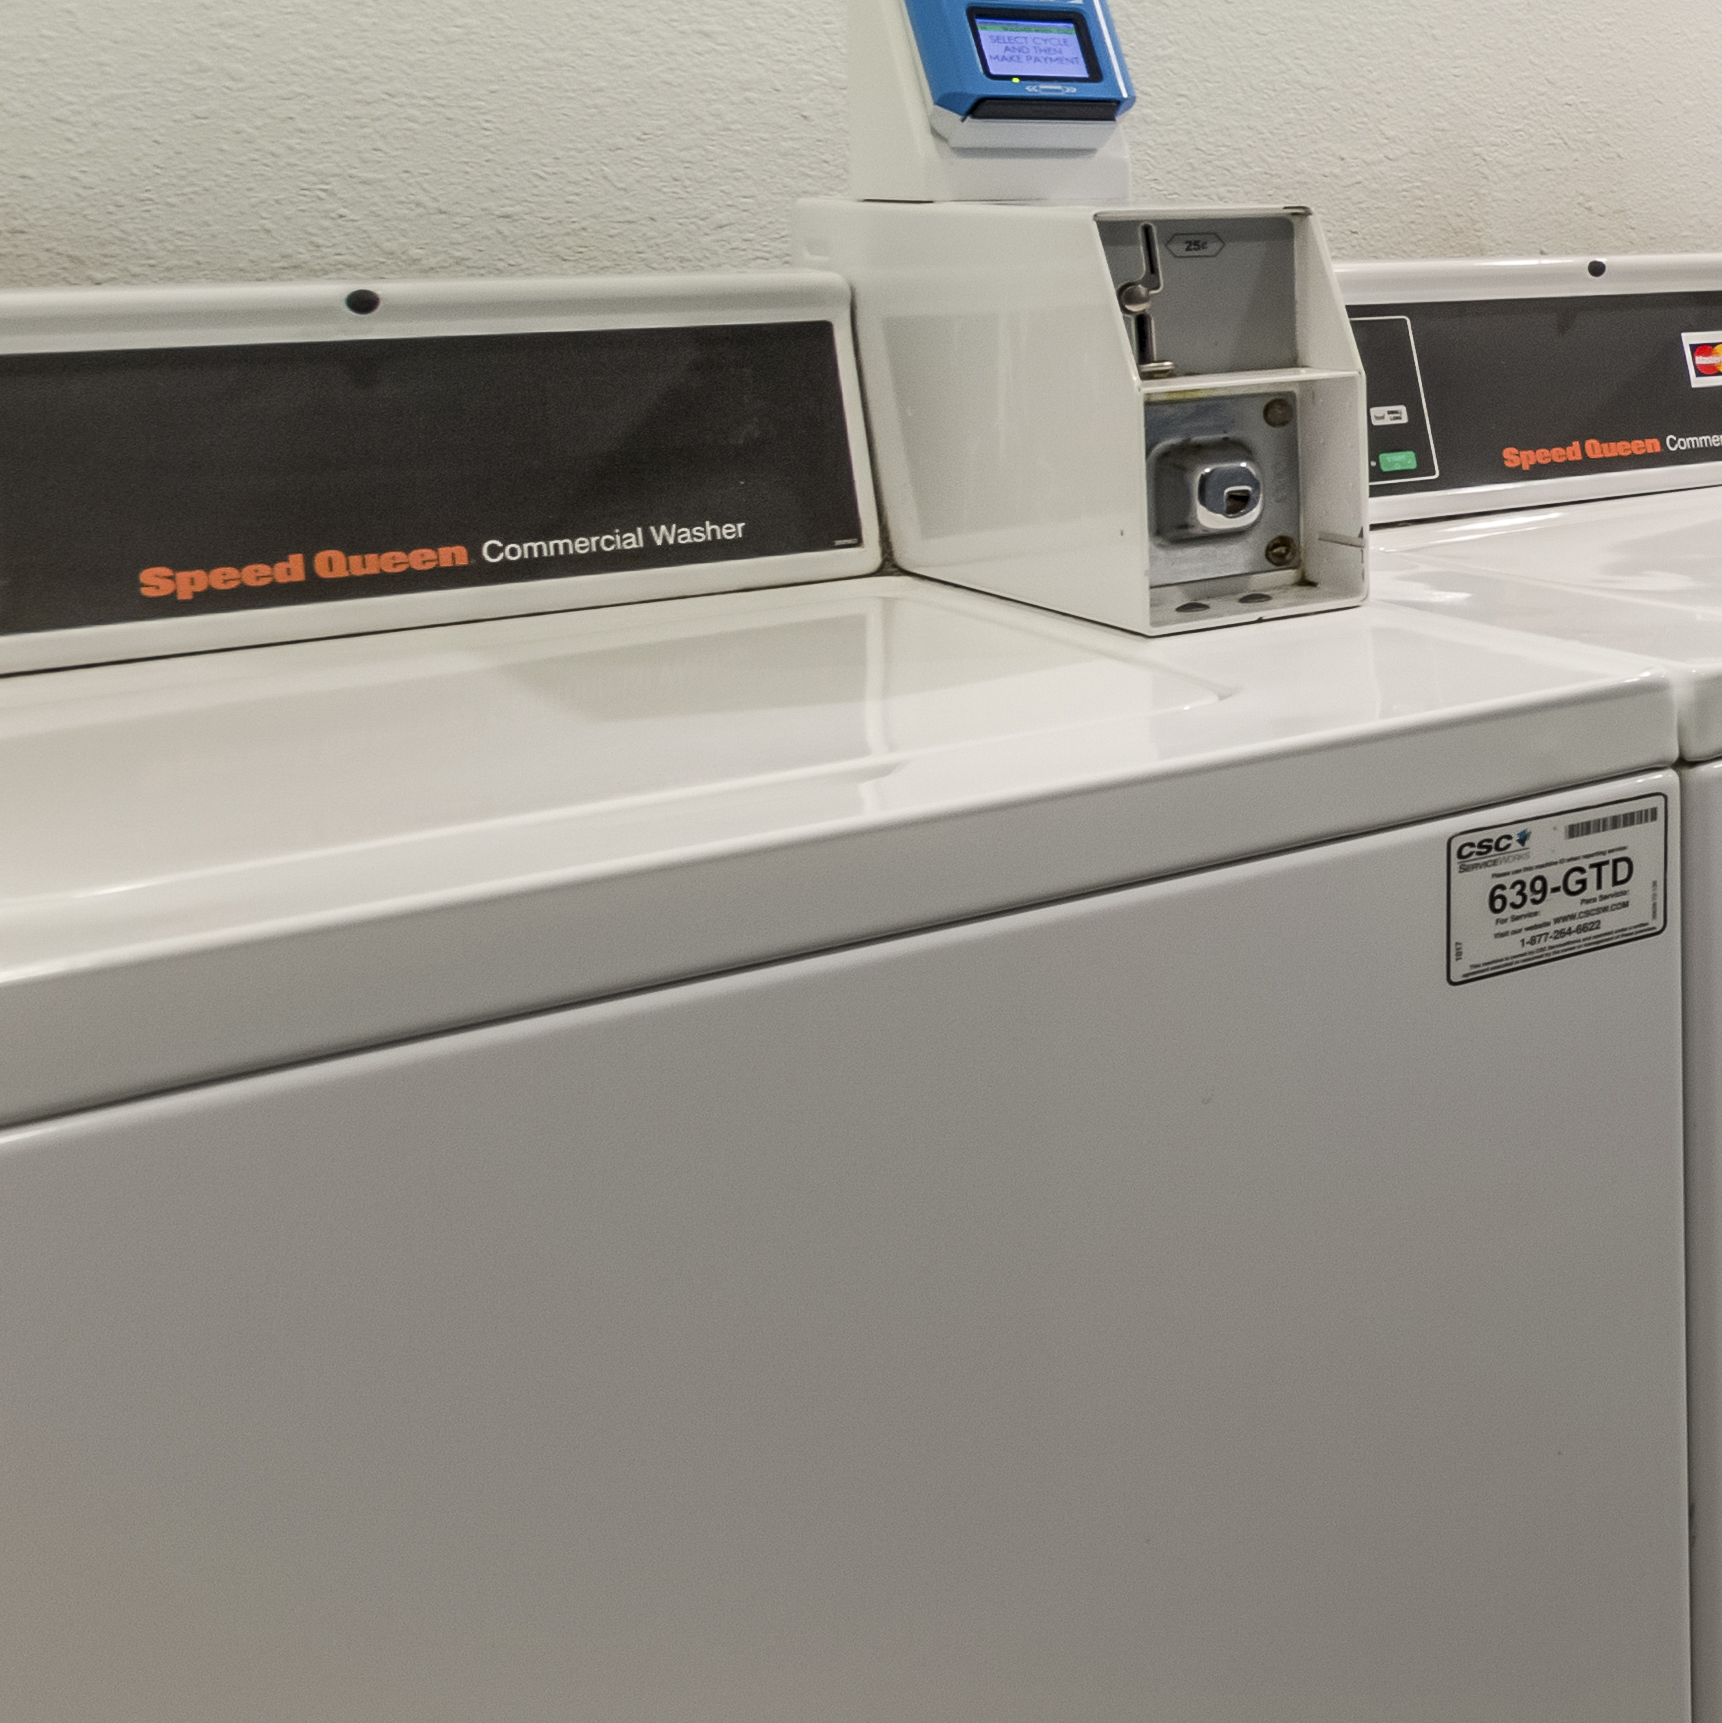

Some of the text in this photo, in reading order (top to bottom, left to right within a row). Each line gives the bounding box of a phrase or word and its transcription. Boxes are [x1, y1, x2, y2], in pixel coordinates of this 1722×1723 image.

[989, 34, 1069, 46] SELECT CYCLE
[1003, 45, 1063, 55] AND THEN
[990, 54, 1080, 65] MAKE PAYMENT
[1502, 441, 1583, 470] Speed
[1584, 437, 1662, 461] Queen
[139, 520, 746, 600] Speed Queen Commercial Washer
[1457, 834, 1514, 860] CSC
[1488, 856, 1634, 914] 639-GTD
